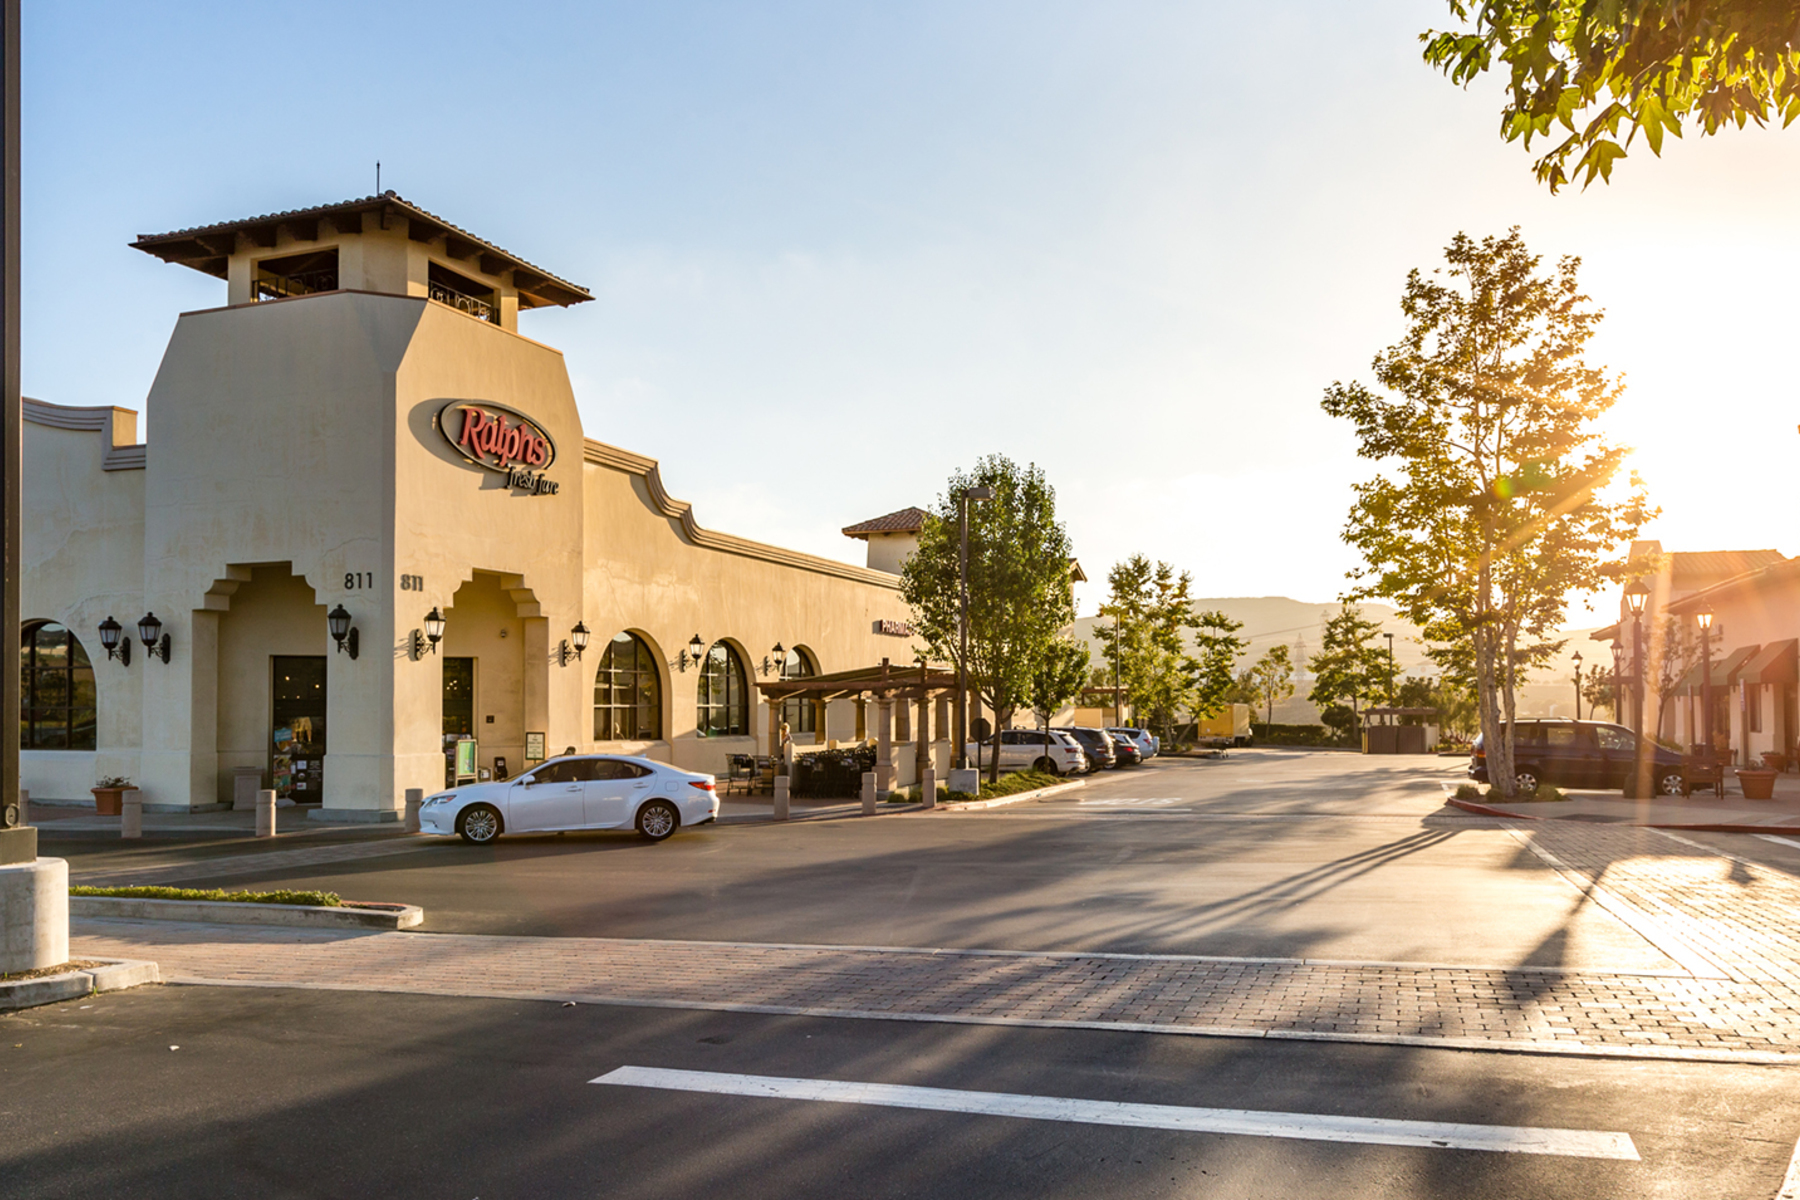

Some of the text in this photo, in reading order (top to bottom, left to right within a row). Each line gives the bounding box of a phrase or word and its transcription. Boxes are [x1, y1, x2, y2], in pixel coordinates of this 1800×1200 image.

[460, 408, 547, 466] Ralphs
[344, 572, 372, 590] 811
[400, 574, 423, 592] 811
[880, 619, 916, 635] PHARMA
